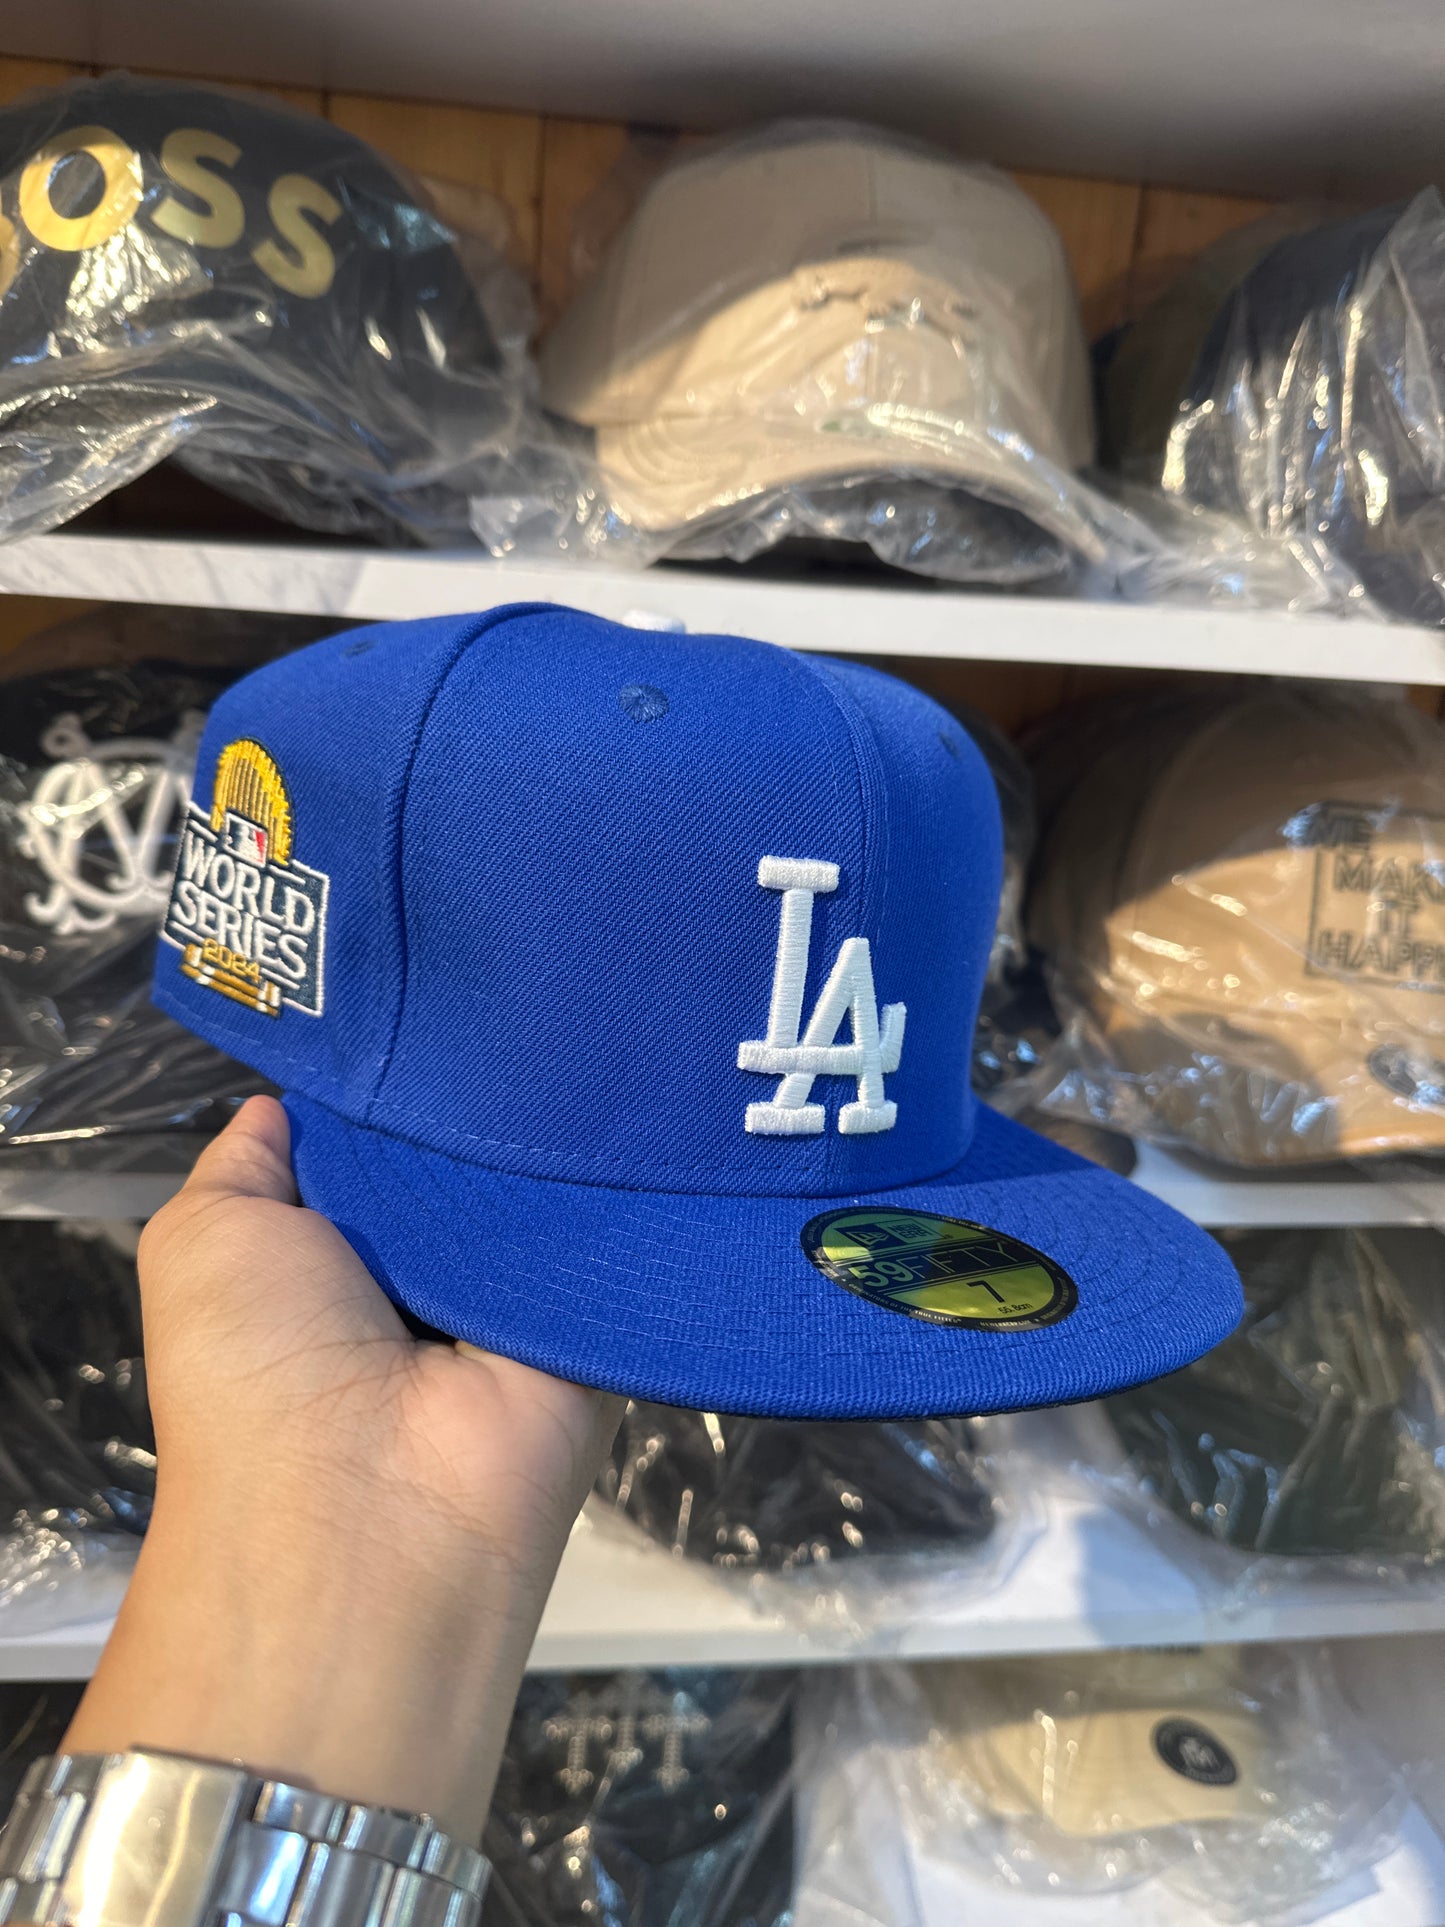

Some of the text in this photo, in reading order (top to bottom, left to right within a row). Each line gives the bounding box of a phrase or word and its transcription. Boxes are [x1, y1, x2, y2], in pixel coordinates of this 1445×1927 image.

[0, 124, 341, 298] OSS
[183, 830, 315, 936] WORLD
[171, 879, 308, 980] SERIES
[203, 937, 262, 984] 2024
[737, 854, 907, 1136] LA
[888, 1223, 922, 1233] NEW
[899, 1228, 936, 1239] ERA
[847, 1241, 1018, 1287] 59FIFTY
[966, 1280, 1005, 1302] 7
